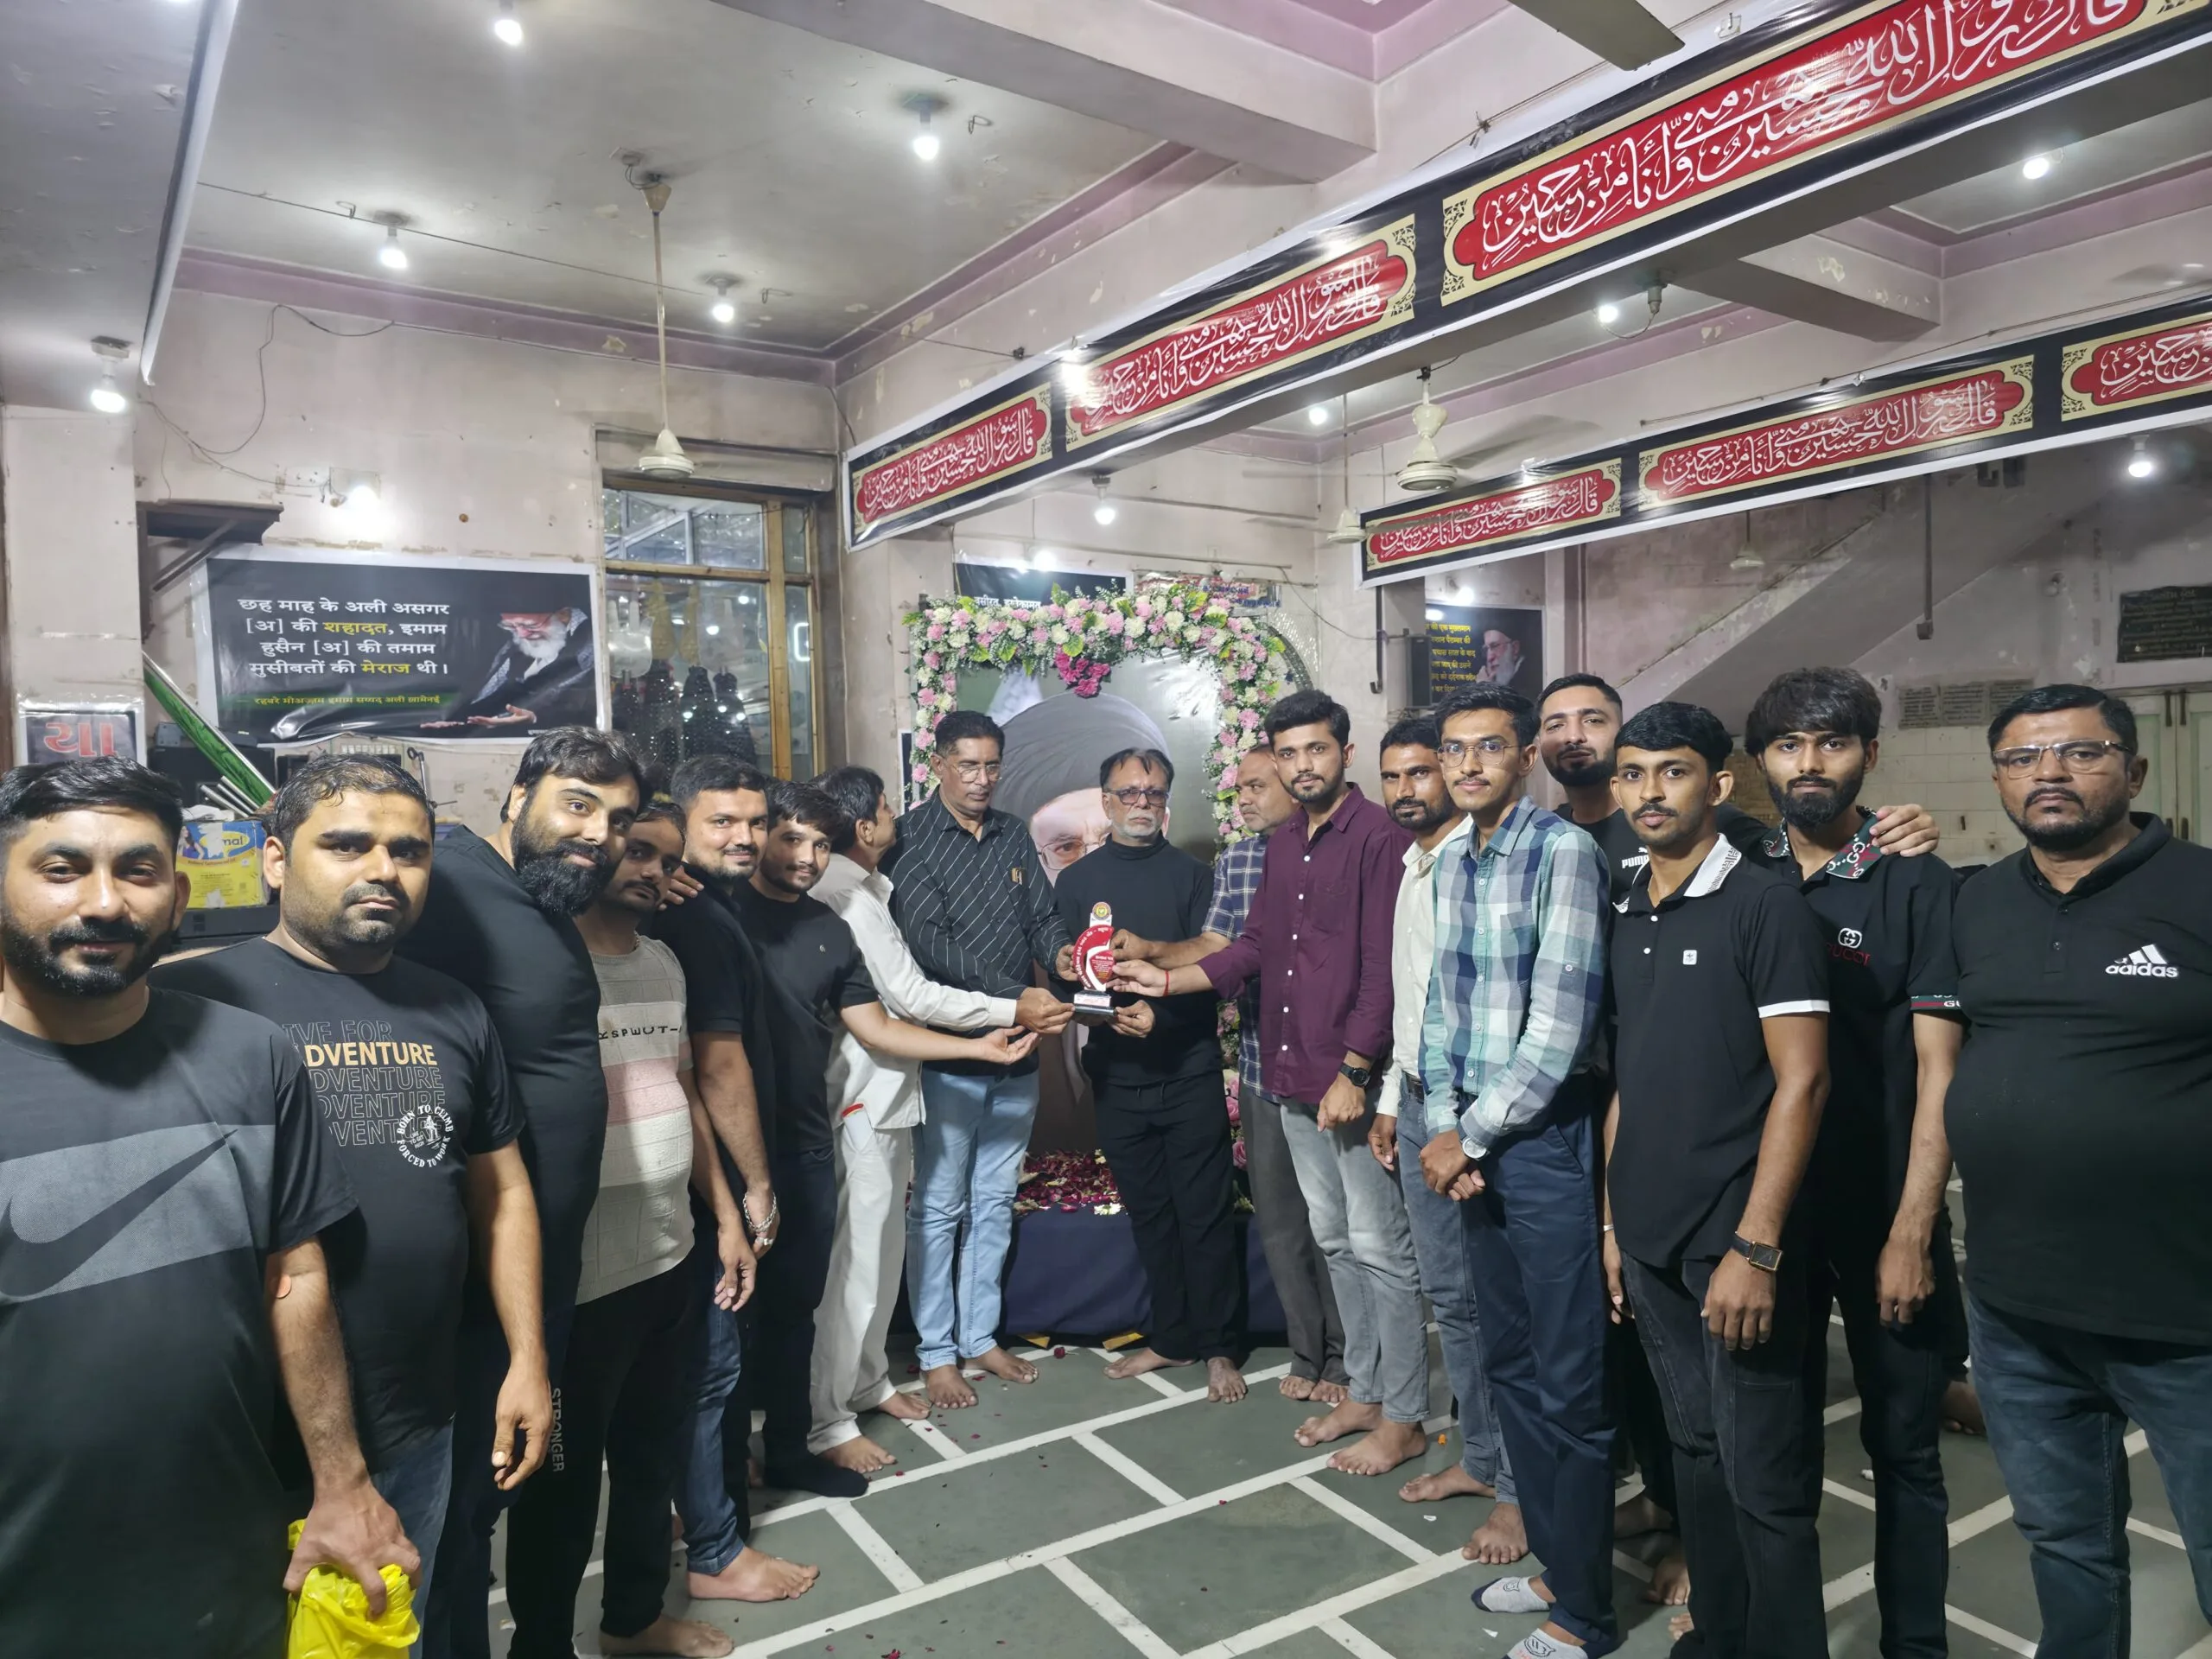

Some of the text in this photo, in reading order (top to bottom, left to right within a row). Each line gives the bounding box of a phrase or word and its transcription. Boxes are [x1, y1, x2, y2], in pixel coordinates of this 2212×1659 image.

[238, 597, 449, 614] छह माह के अली असगर
[291, 618, 318, 633] की
[323, 621, 394, 635] शहादत,
[400, 623, 446, 635] इमाम
[260, 638, 305, 657] हुसैन
[357, 639, 382, 654] की
[387, 642, 435, 654] तमाम
[249, 659, 325, 677] मुसीबतों
[330, 660, 356, 674] की
[361, 660, 410, 674] मेराज
[385, 695, 404, 703] अली
[1622, 855, 1649, 868] PUMA
[1826, 943, 1871, 966] UCCI
[2105, 963, 2178, 977] adidas
[283, 1020, 394, 1046] IVE FOR
[304, 1042, 438, 1067] DVENTURE
[397, 1104, 454, 1135] BORN TO CLIMB
[397, 1136, 450, 1167] FORCED TO WORK
